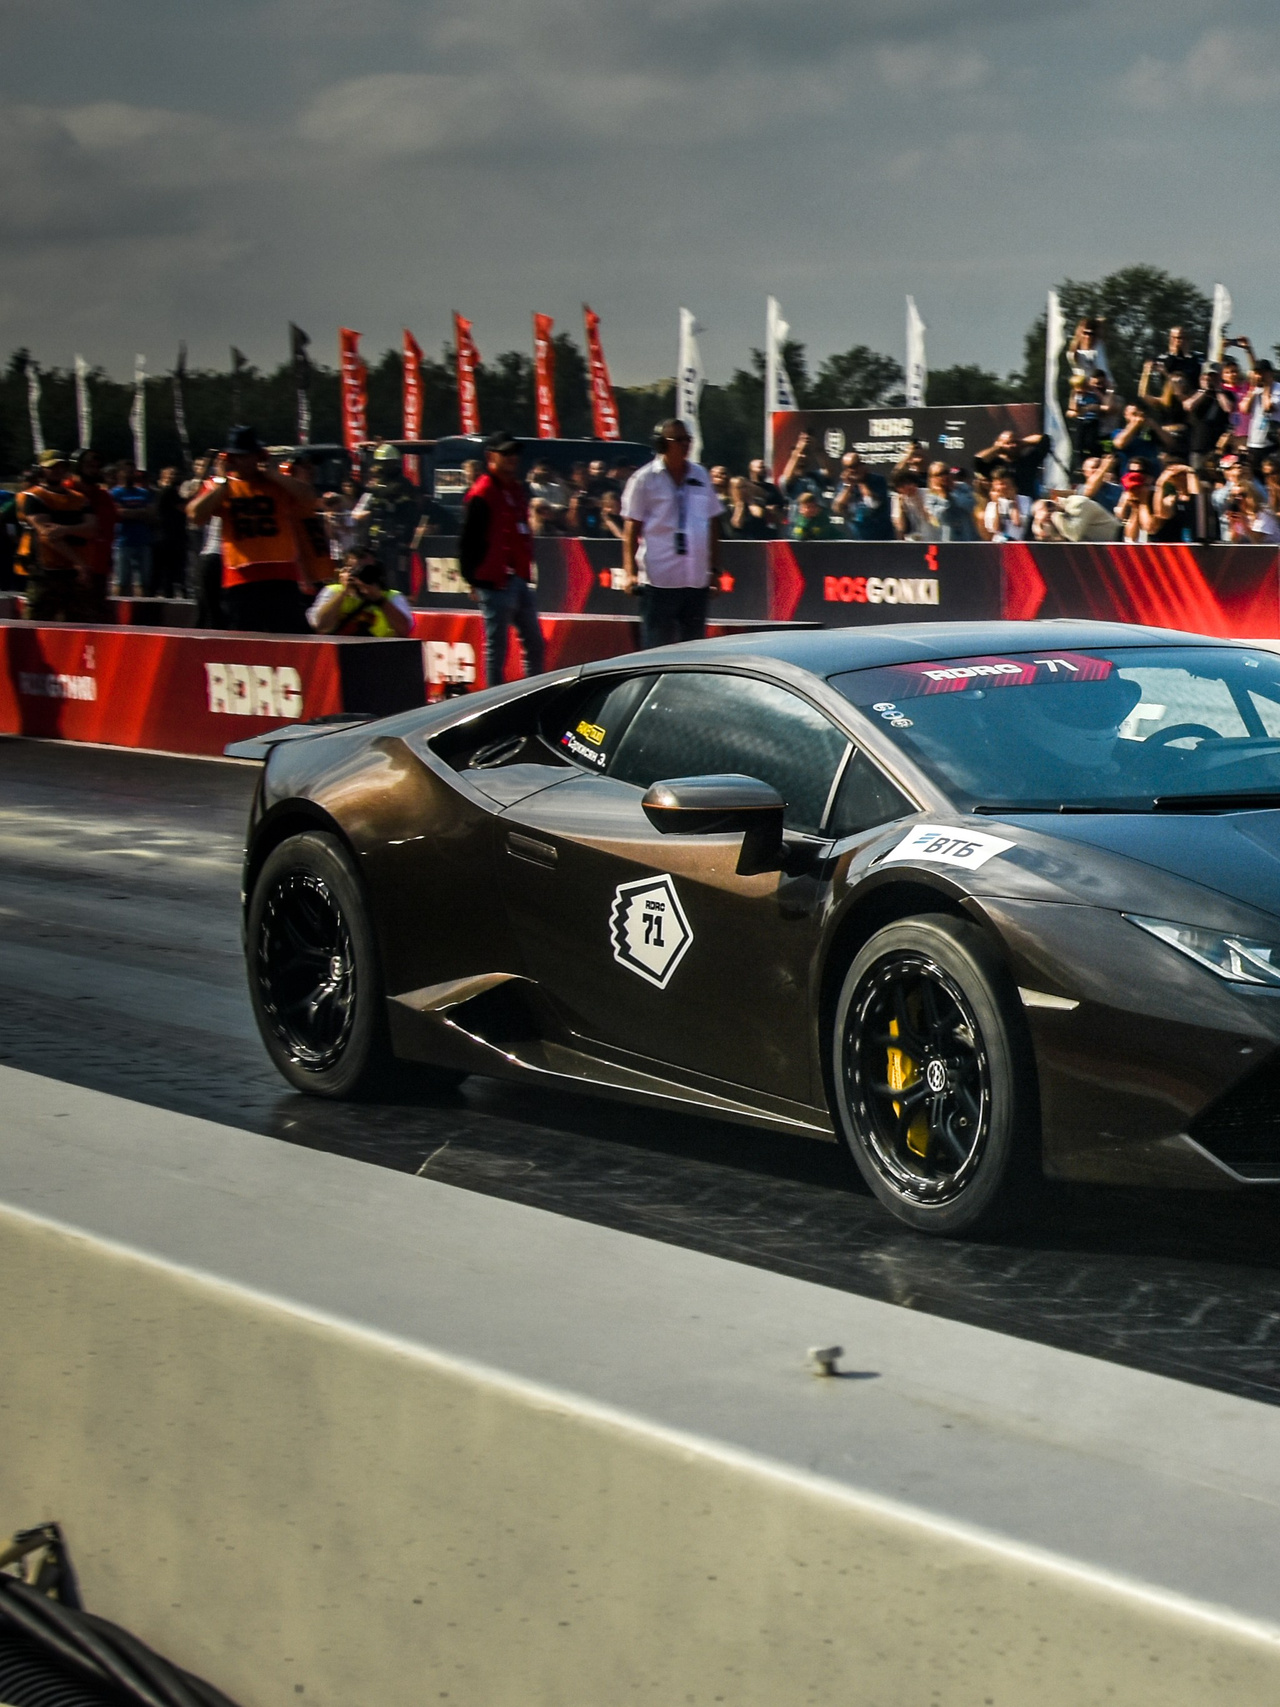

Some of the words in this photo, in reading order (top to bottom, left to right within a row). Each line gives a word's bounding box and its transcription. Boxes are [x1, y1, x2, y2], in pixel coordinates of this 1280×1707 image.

[823, 576, 940, 605] ROSGONKI
[921, 663, 1023, 681] RDRC
[1033, 659, 1080, 673] 71
[204, 662, 303, 719] RDRC
[922, 837, 984, 858] ВТБ
[645, 900, 665, 912] RDRC
[642, 912, 665, 948] 71
